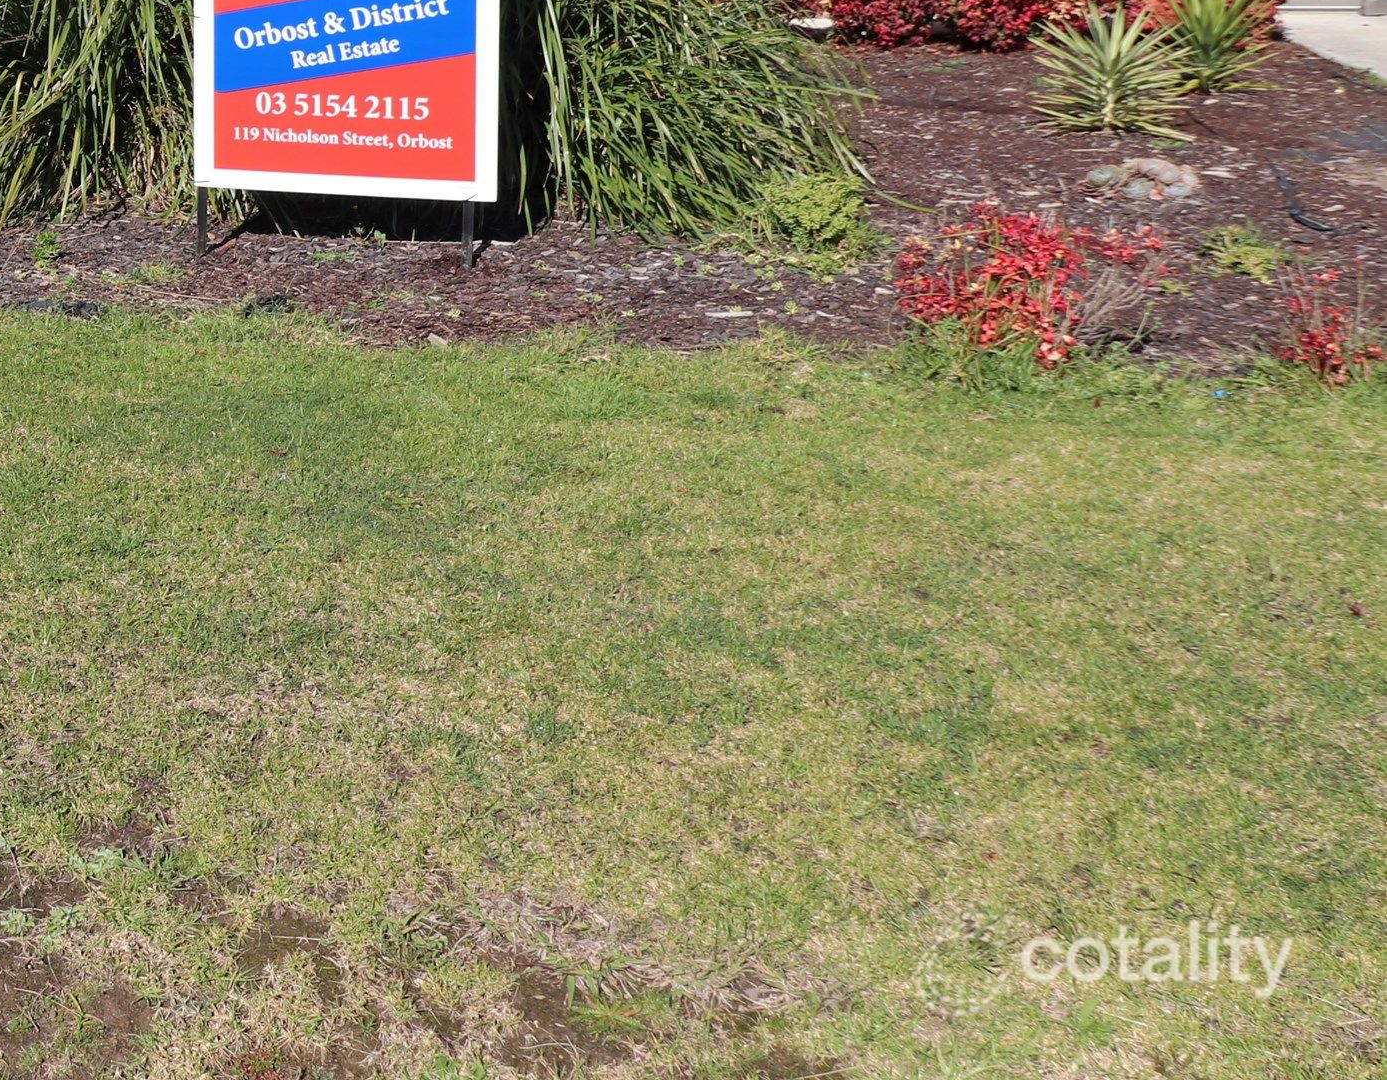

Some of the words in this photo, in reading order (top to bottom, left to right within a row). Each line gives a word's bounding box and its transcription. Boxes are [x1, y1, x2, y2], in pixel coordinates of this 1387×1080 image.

[233, 17, 319, 50] Orbost
[323, 11, 346, 34] &
[291, 43, 336, 69] Real
[338, 37, 401, 62] Estate
[255, 91, 287, 115] 03
[294, 93, 358, 118] 5154
[363, 95, 430, 121] 2115
[233, 126, 259, 141] 119
[262, 127, 339, 145] Nicholson
[342, 131, 394, 150] Street,
[397, 133, 453, 150] Orbost
